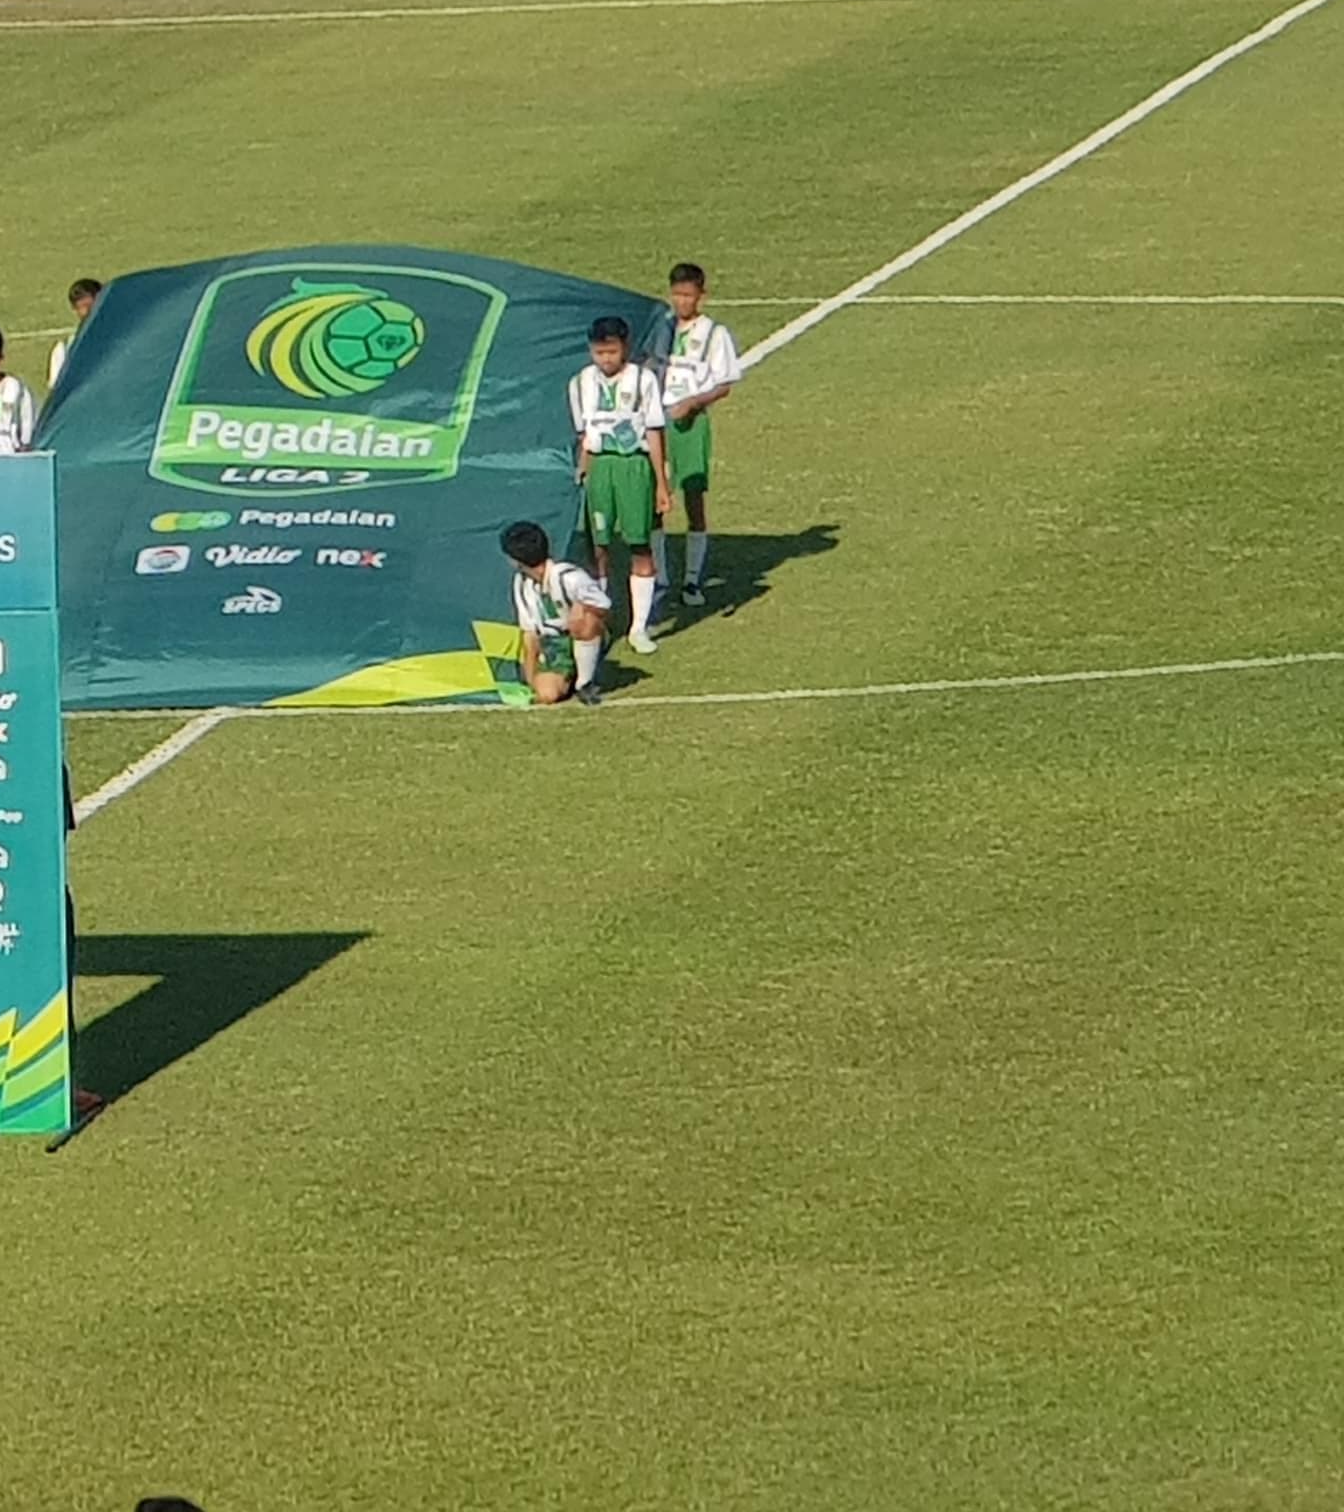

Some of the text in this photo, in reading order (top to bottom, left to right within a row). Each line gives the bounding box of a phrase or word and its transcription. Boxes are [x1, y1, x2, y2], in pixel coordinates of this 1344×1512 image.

[187, 411, 432, 459] Pegadaian
[220, 467, 370, 484] LIGA 2
[239, 509, 395, 528] Pegadaian
[205, 544, 302, 567] Vidio
[317, 548, 387, 569] nex
